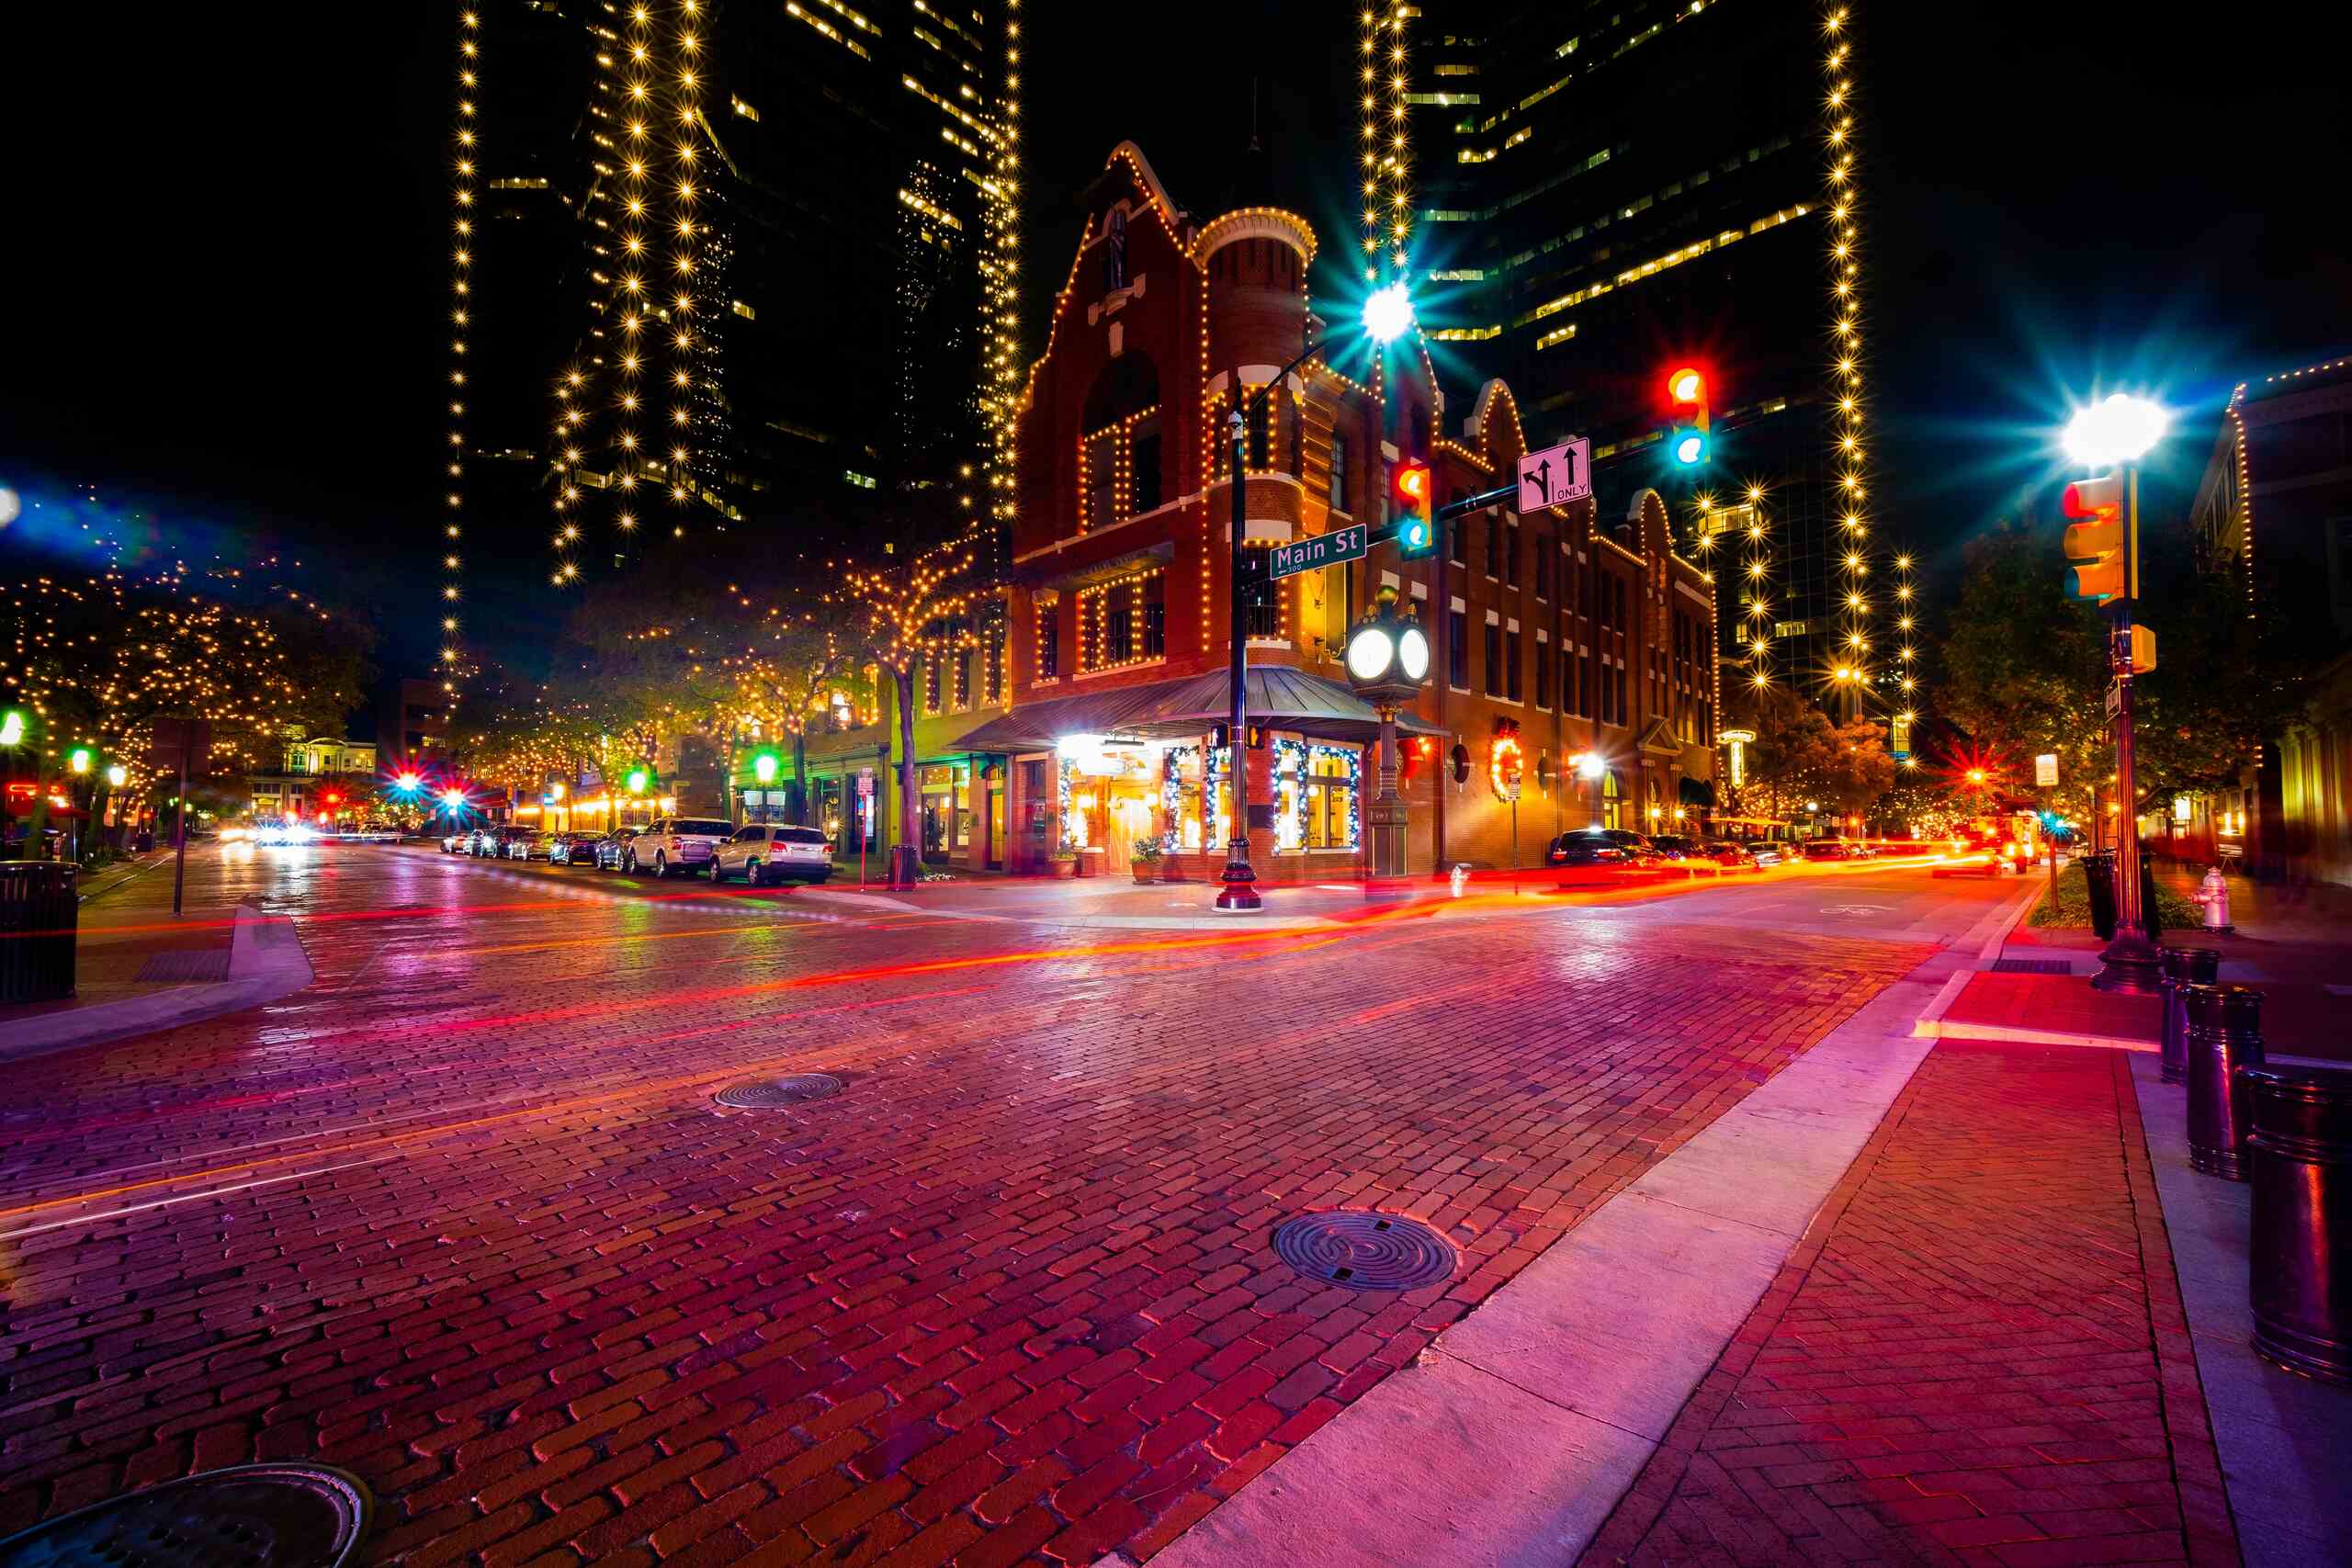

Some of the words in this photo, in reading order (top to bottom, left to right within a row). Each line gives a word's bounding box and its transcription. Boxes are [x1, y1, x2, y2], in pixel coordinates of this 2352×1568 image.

[1557, 483, 1587, 500] ONLY
[1277, 542, 1325, 569] Main
[1335, 531, 1358, 553] St
